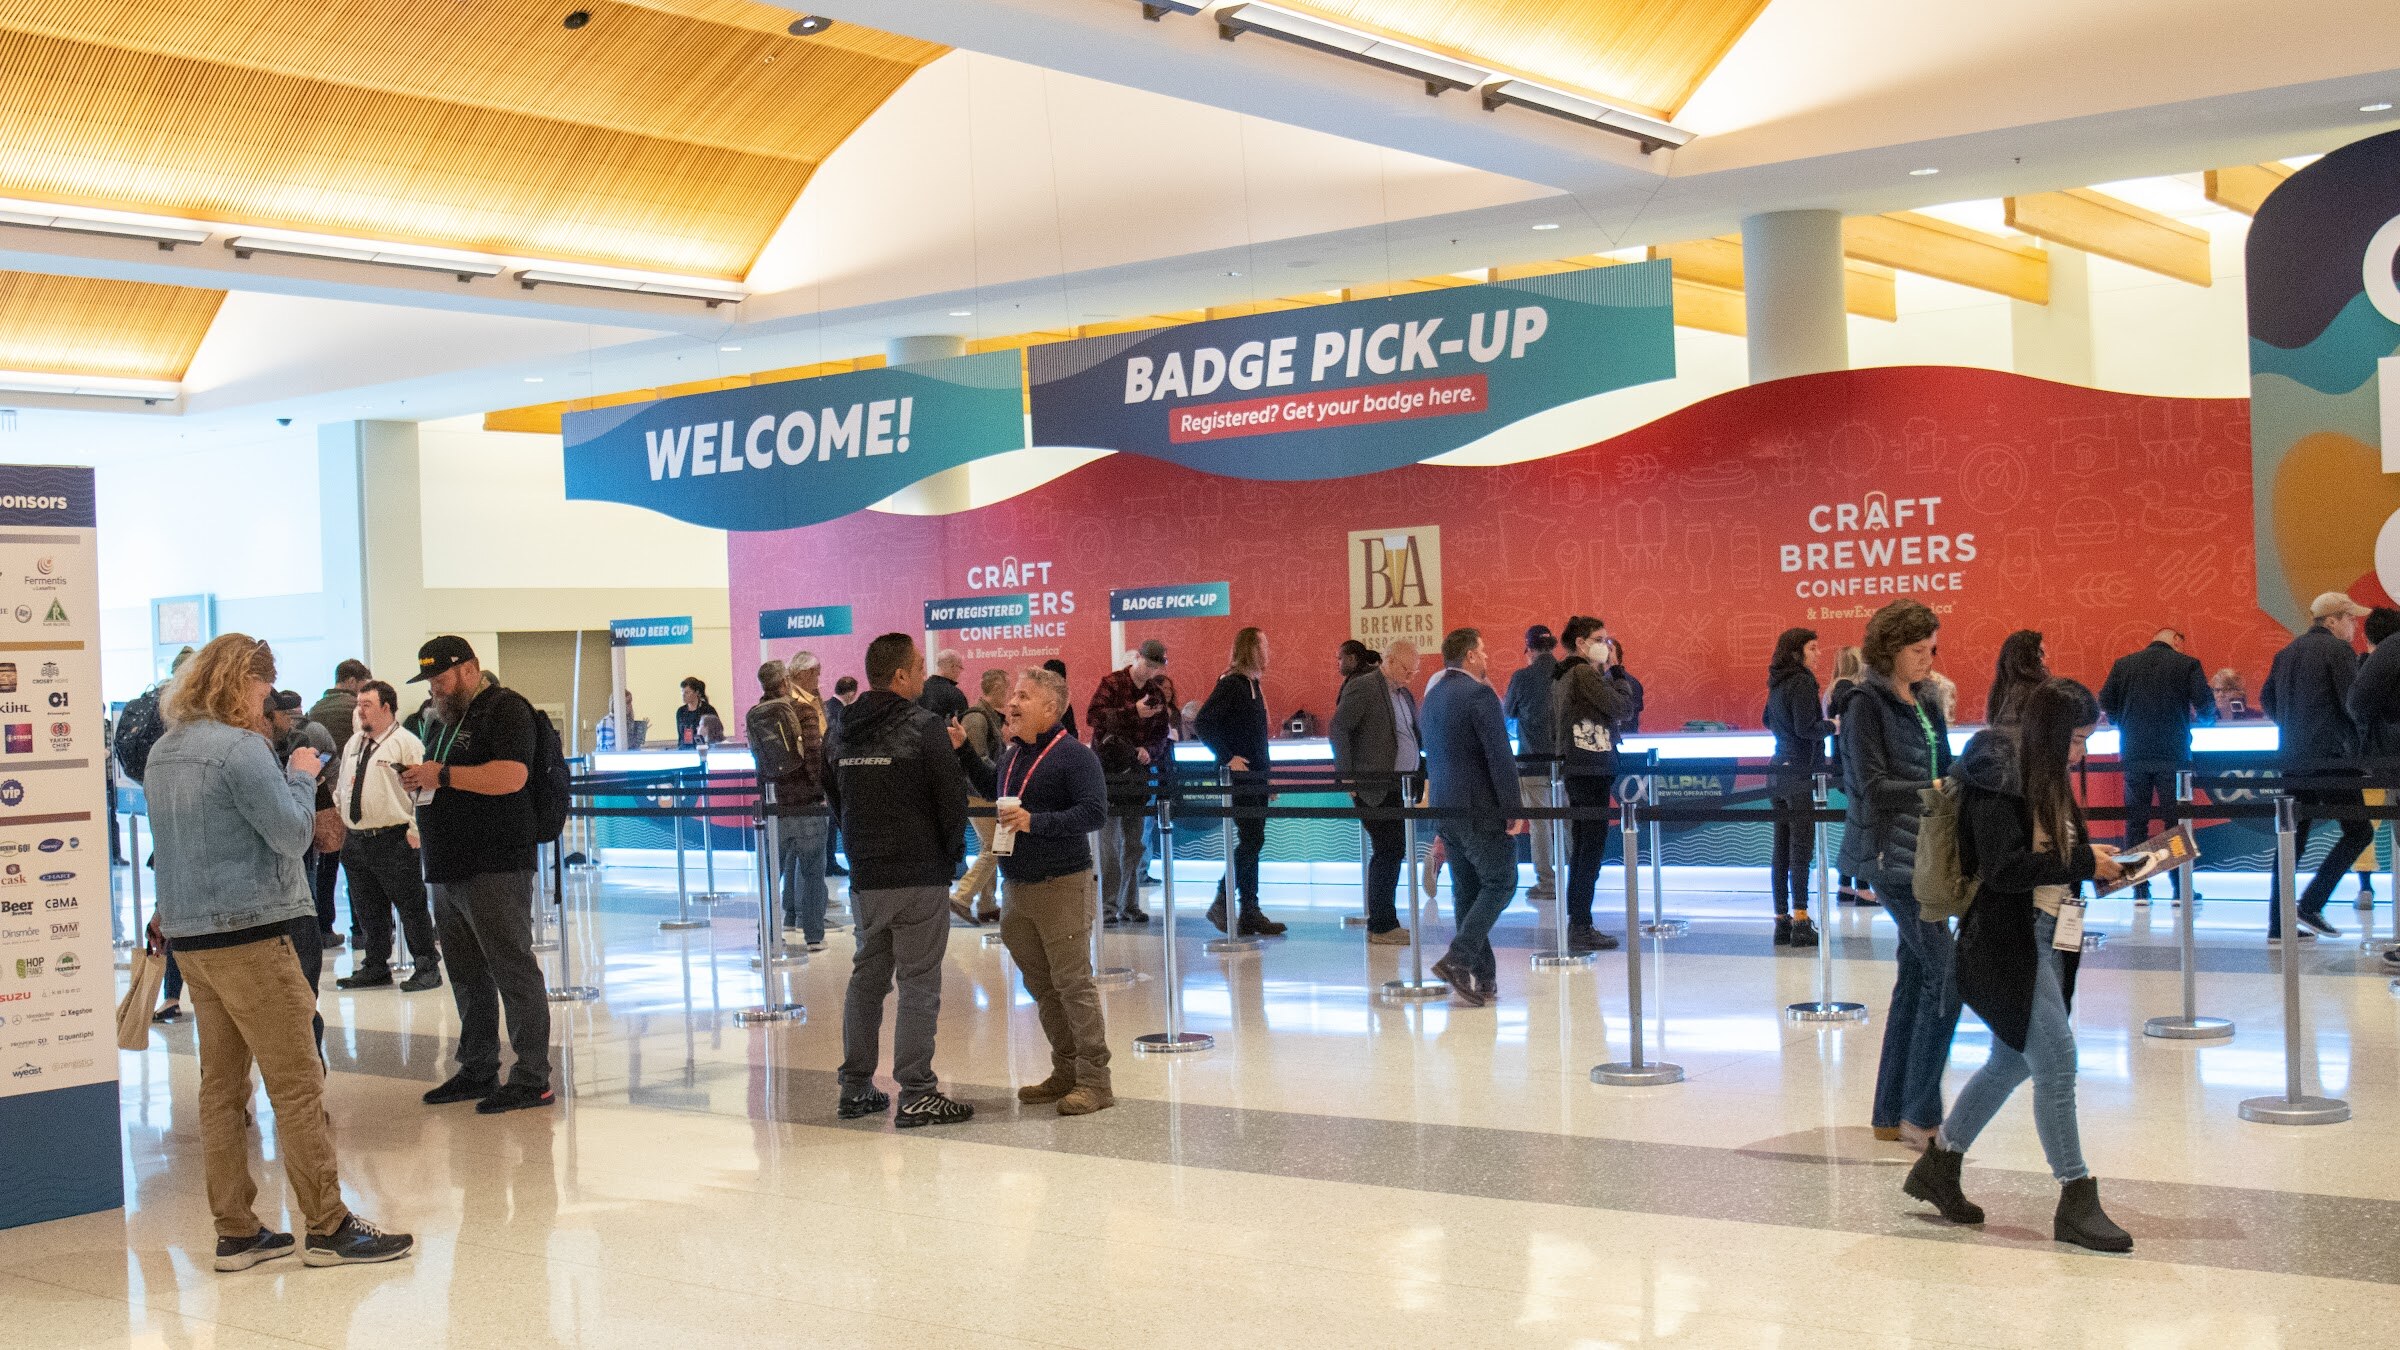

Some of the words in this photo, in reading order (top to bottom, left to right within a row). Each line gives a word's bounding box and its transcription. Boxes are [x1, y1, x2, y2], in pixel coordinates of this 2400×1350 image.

[1124, 336, 1299, 404] BADGE
[1311, 306, 1549, 383] PICK-UP
[1181, 406, 1279, 433] Registered?
[1283, 402, 1314, 421] Get
[1318, 398, 1360, 420] your
[1364, 388, 1425, 414] badge
[1429, 385, 1477, 406] here.
[645, 397, 914, 481] WELCOME!
[1809, 496, 1942, 533] CRAFT
[1780, 533, 1977, 572] BREWERS
[25, 576, 67, 585] Fermentis
[967, 561, 1052, 589] CRAFT
[1796, 572, 1963, 598] CONFERENCE
[1122, 597, 1163, 610] BADGE
[1166, 593, 1217, 608] PICK-UP
[931, 608, 954, 621] NOT
[956, 604, 1023, 619] REGISTERED
[1807, 608, 1816, 620] &
[1821, 604, 1879, 620] BrewEx
[787, 614, 825, 629] MEDIA
[1361, 614, 1433, 634] BREWERS
[615, 627, 645, 638] WORLD
[648, 625, 669, 637] BEER
[672, 624, 689, 636] CUP
[960, 622, 1066, 641] CONFERENCE
[968, 650, 973, 658] &
[976, 648, 1020, 659] BrewExpo
[1022, 646, 1059, 656] America
[839, 757, 892, 767] SKECHERS
[1657, 775, 1721, 790] ALPHA
[1, 874, 26, 885] cask
[42, 873, 73, 881] CHART
[1, 901, 34, 912] Beer
[45, 897, 78, 909] CBMA
[51, 924, 78, 934] DMM
[26, 957, 45, 967] HOP
[68, 1007, 93, 1018] Kegshoe
[64, 1031, 94, 1042] quantiphi
[12, 1067, 42, 1079] wyeast
